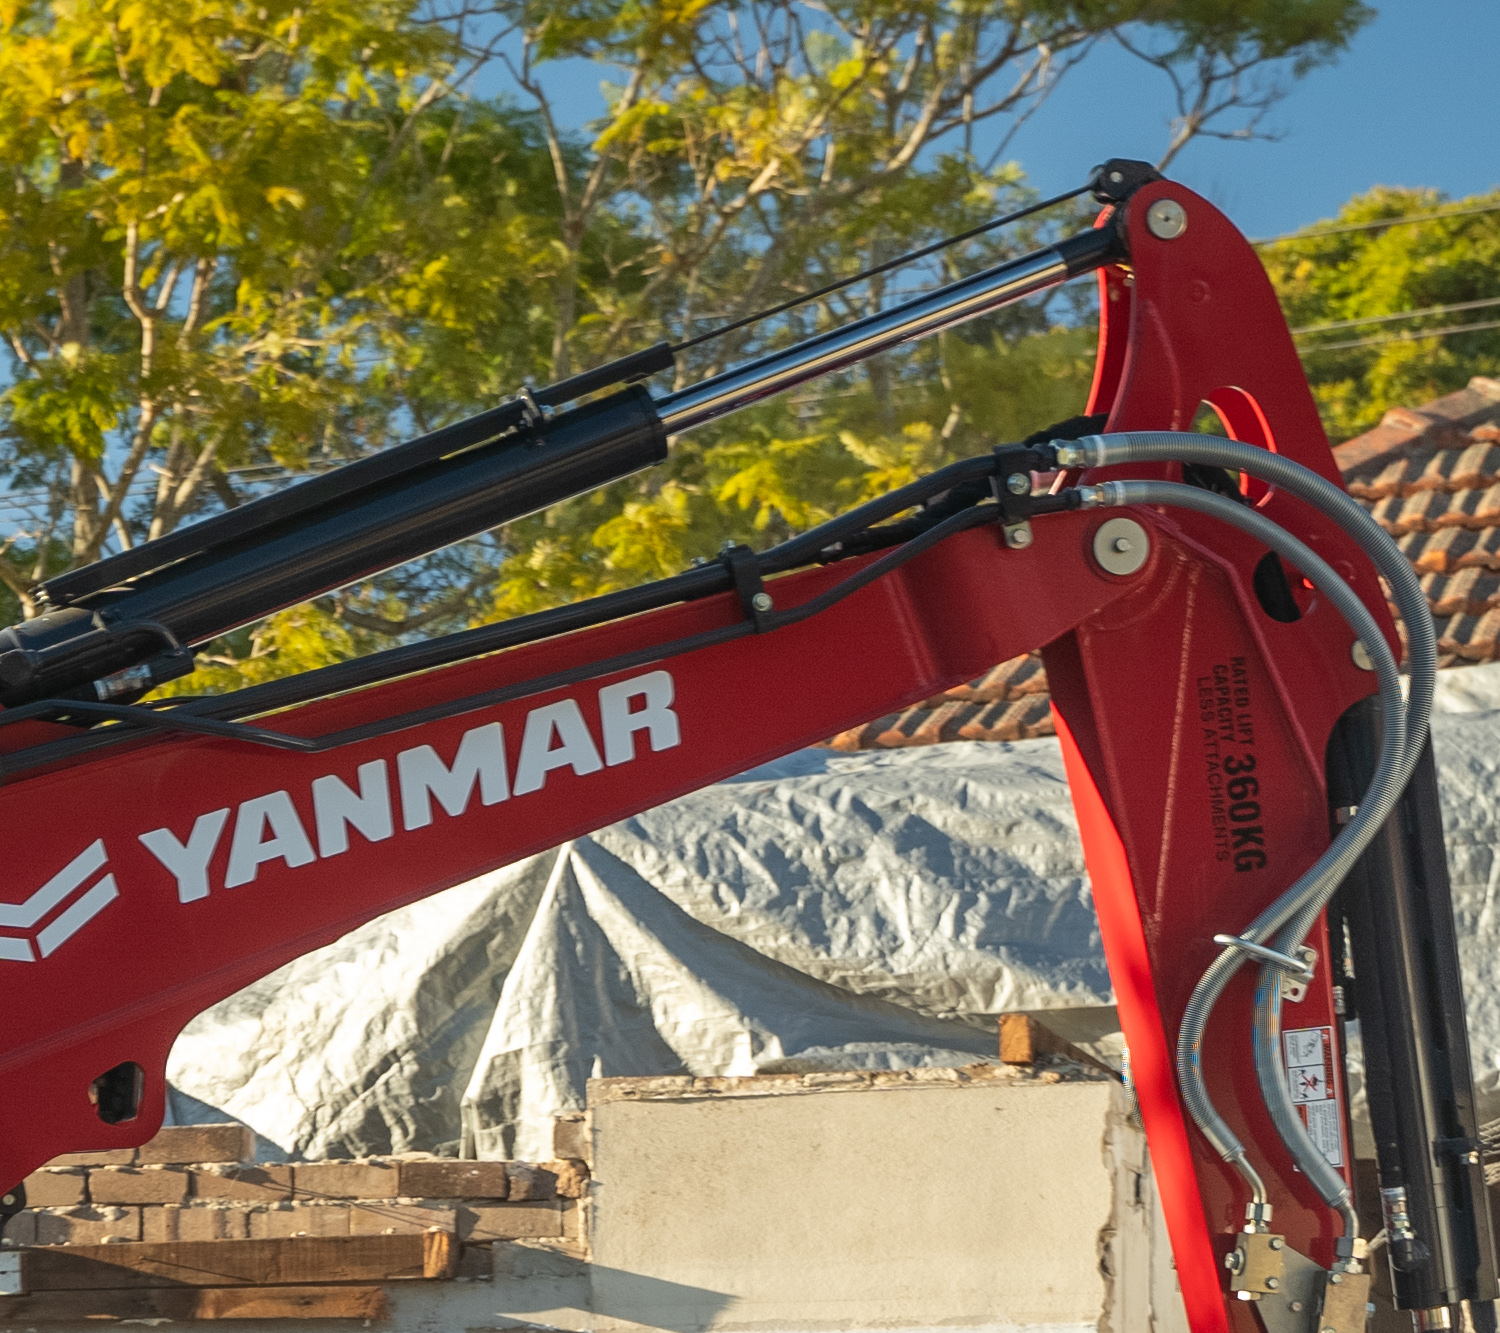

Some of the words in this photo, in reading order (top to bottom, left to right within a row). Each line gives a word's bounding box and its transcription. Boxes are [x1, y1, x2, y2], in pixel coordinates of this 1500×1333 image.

[1197, 676, 1216, 722] LESS
[1213, 664, 1235, 742] CAPACITY
[1230, 657, 1250, 708] RATED
[1236, 713, 1255, 745] LIFT
[138, 669, 681, 904] YANMAR
[1202, 728, 1231, 862] ATTACHMENTS
[1223, 753, 1267, 873] 360KG
[1323, 1042, 1333, 1088] WARNING
